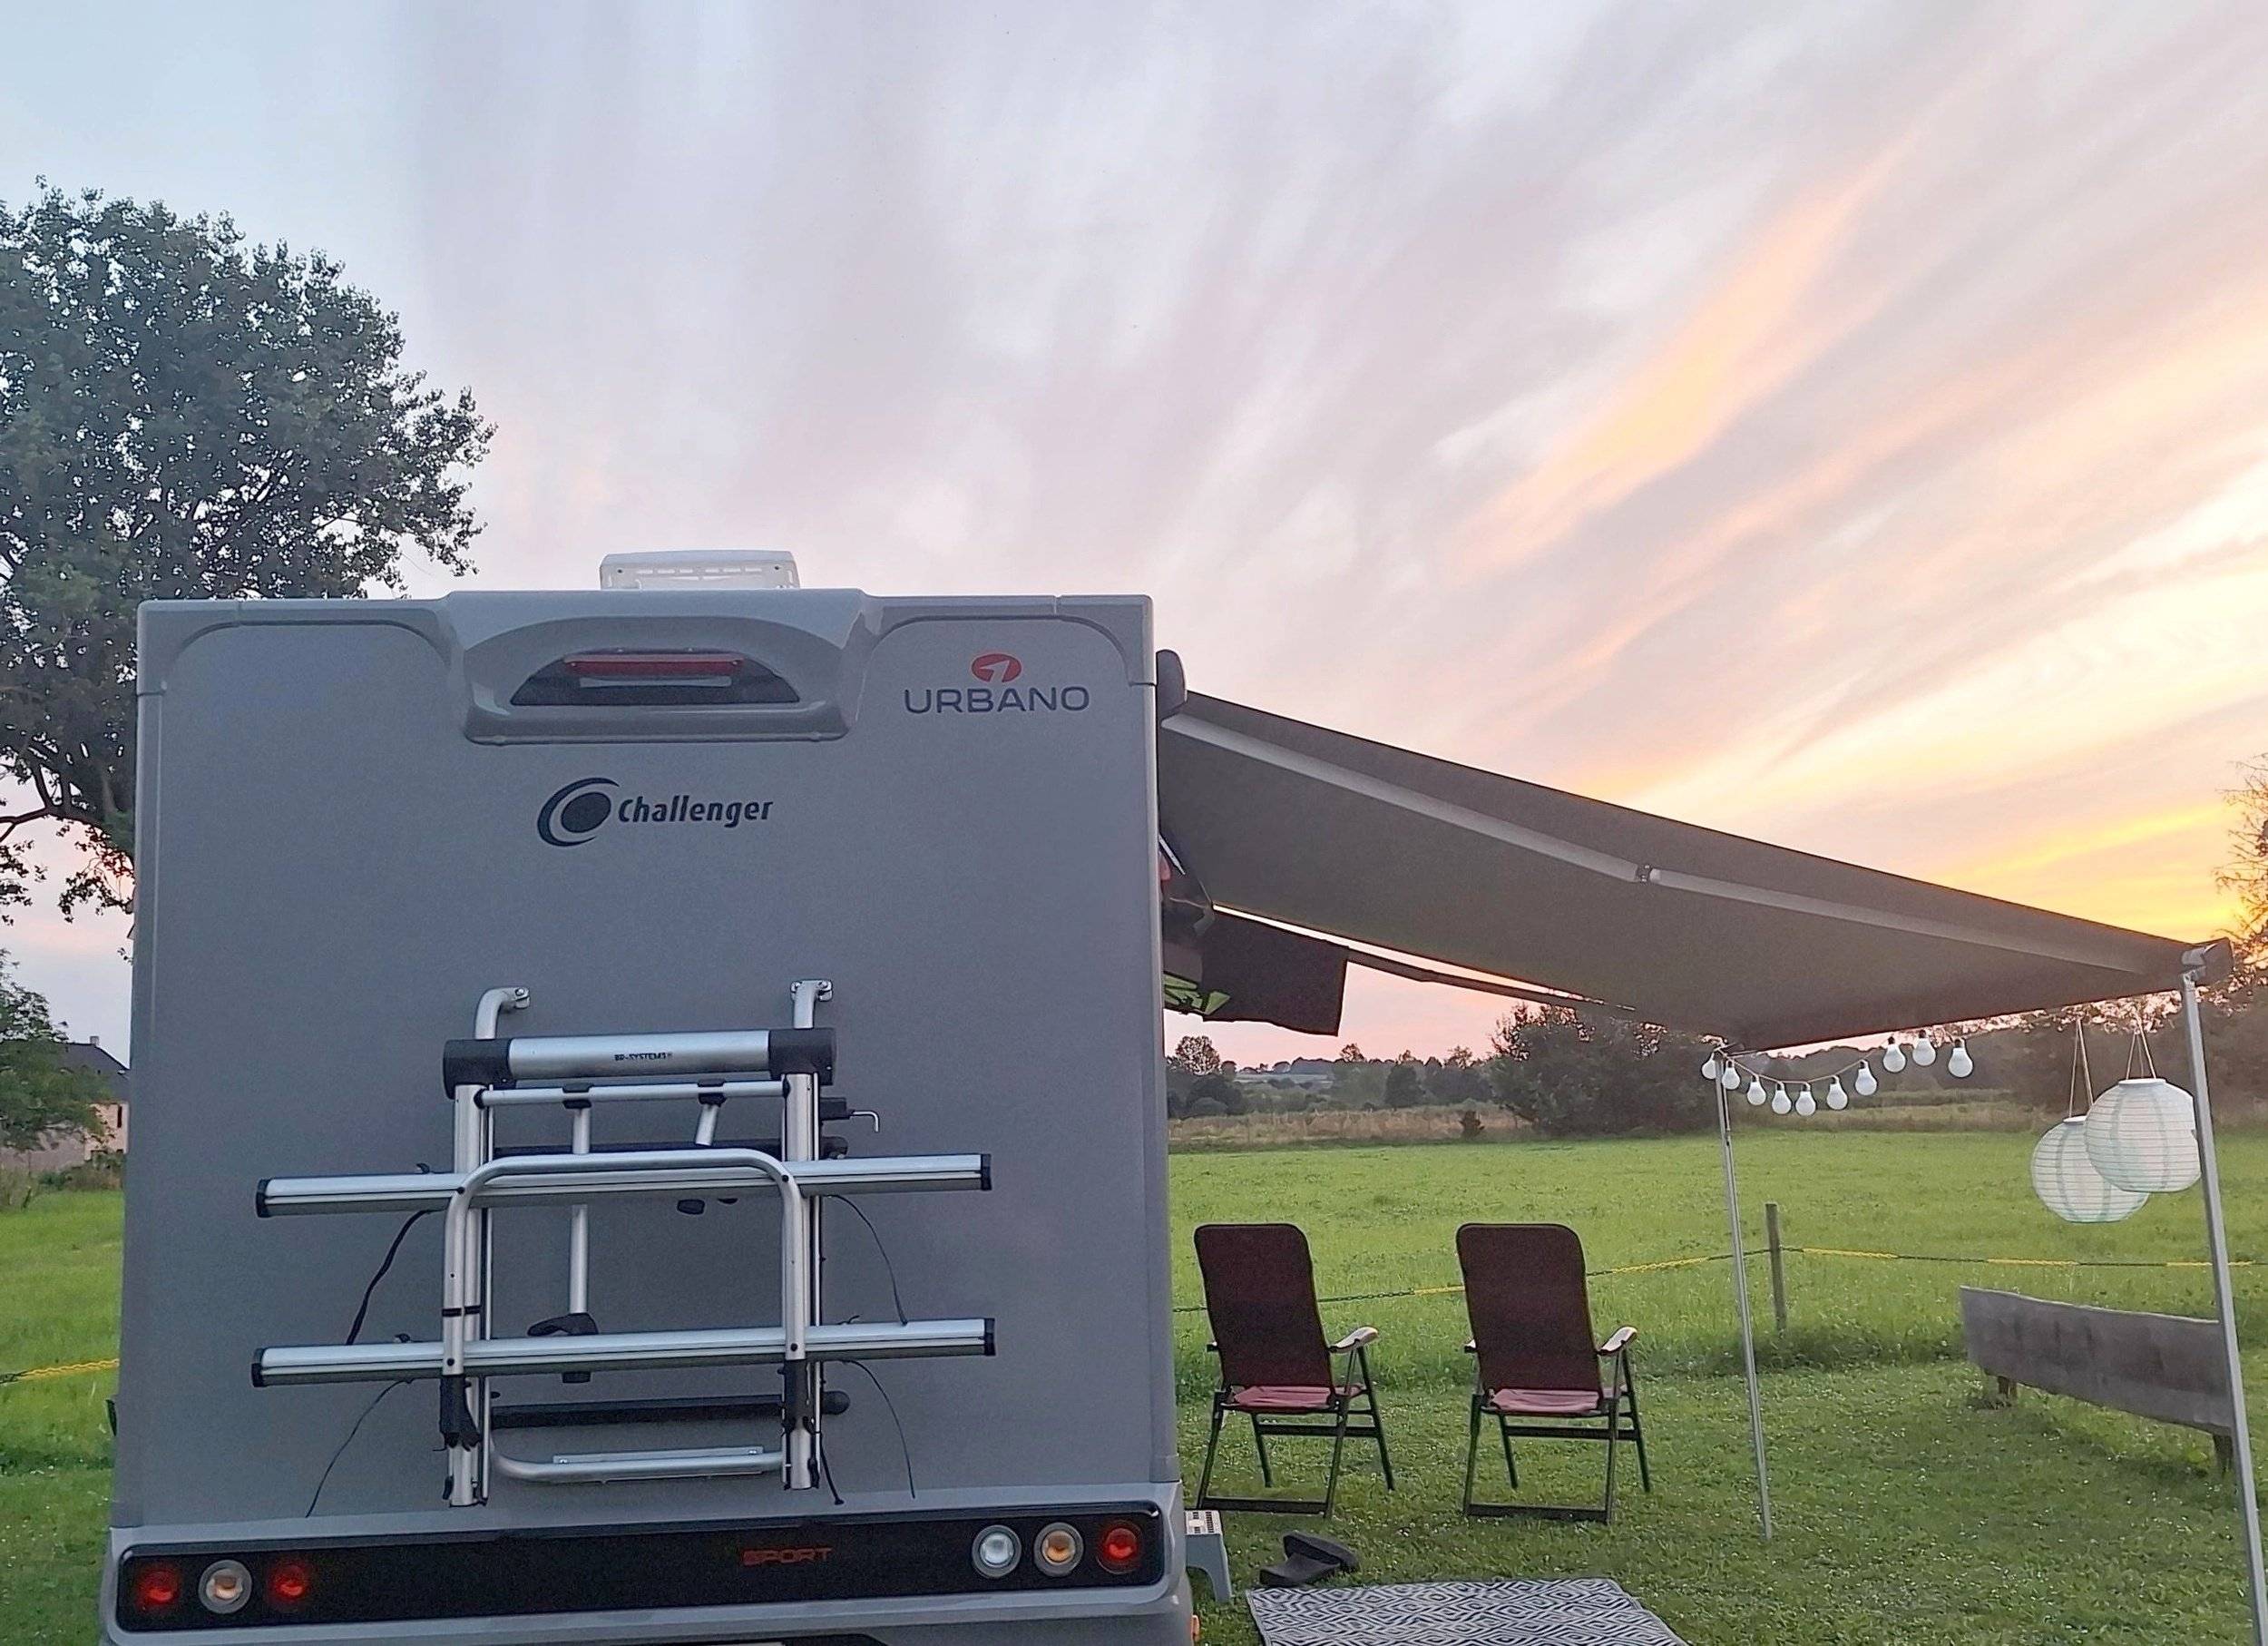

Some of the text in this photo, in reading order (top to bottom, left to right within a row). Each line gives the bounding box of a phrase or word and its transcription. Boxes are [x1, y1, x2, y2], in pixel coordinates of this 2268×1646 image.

[904, 686, 1090, 714] URBANO
[618, 795, 774, 828] Challenger
[741, 1547, 833, 1566] SPORT
